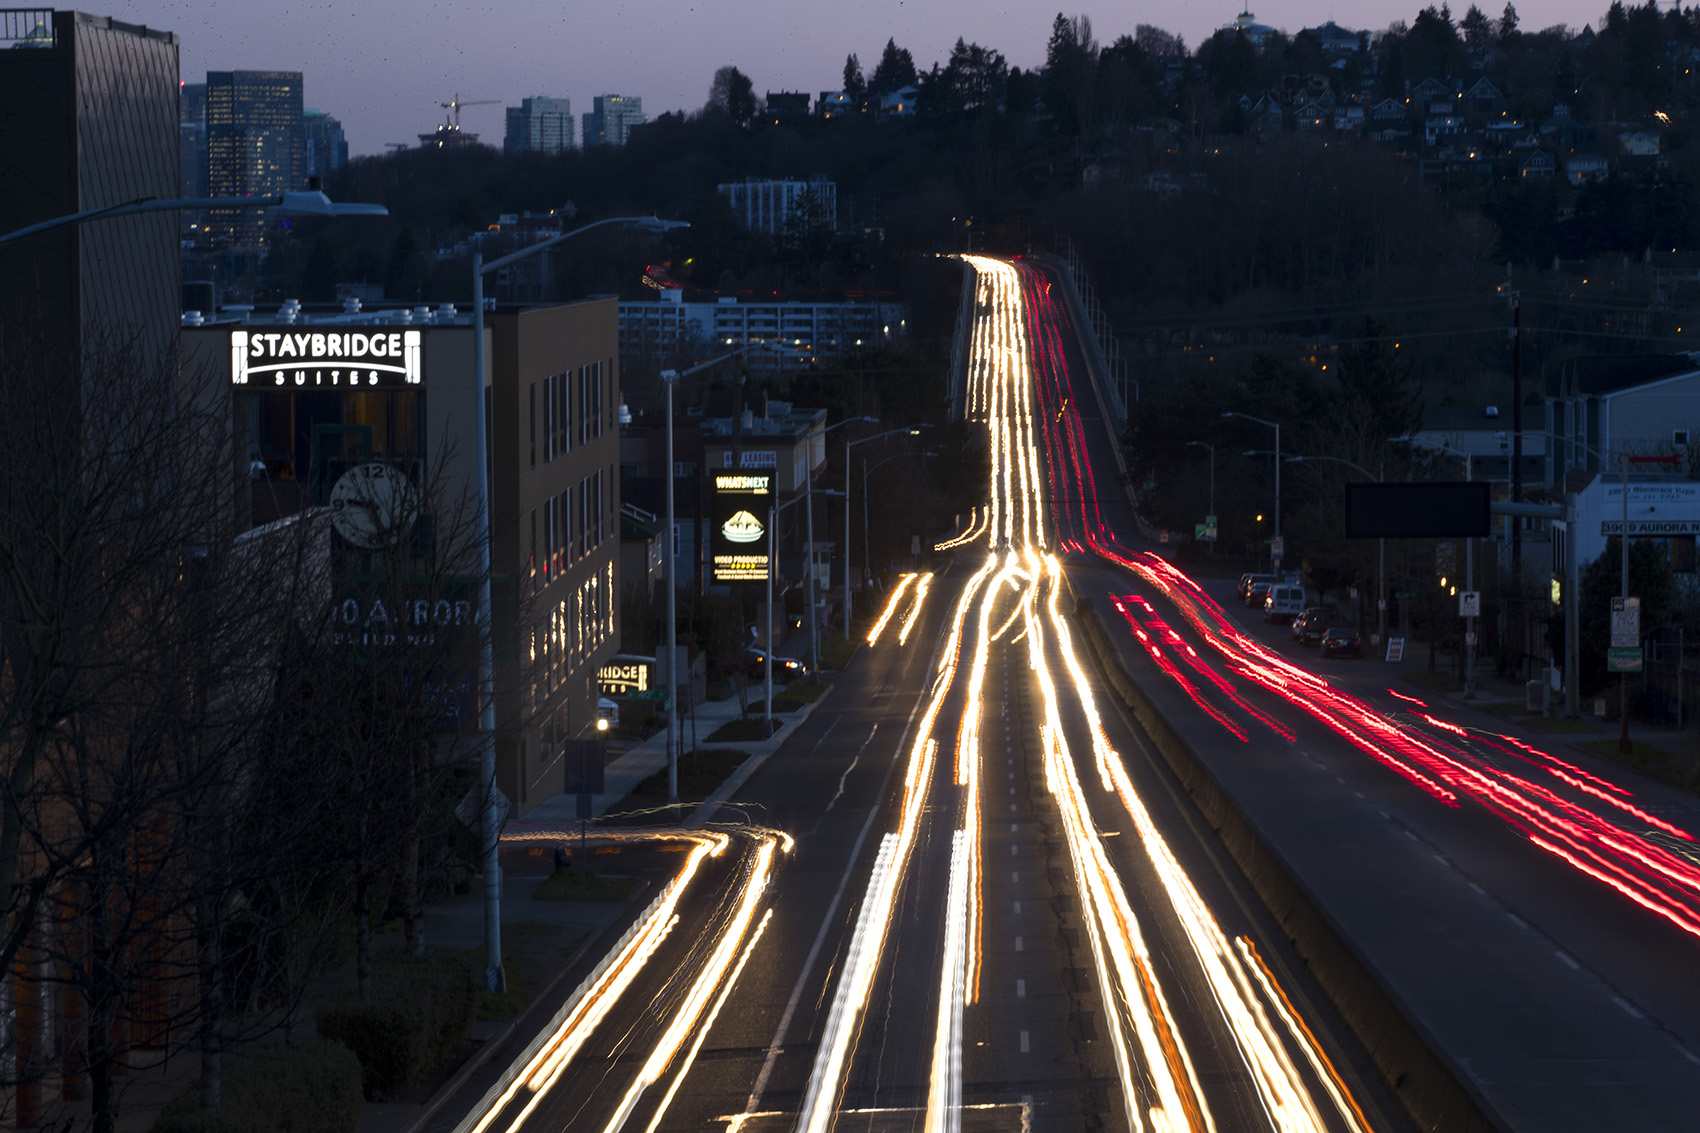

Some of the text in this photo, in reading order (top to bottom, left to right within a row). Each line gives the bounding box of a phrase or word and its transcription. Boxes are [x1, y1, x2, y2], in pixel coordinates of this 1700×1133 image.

[251, 333, 402, 357] STAYBRIDGE
[275, 370, 379, 385] SUITES
[744, 453, 775, 463] LEASING
[364, 465, 385, 478] 12
[716, 476, 770, 489] WHATSNEXT
[1639, 523, 1688, 532] AURORA
[733, 555, 769, 564] PRODUCTIO
[597, 665, 638, 679] RIDGE
